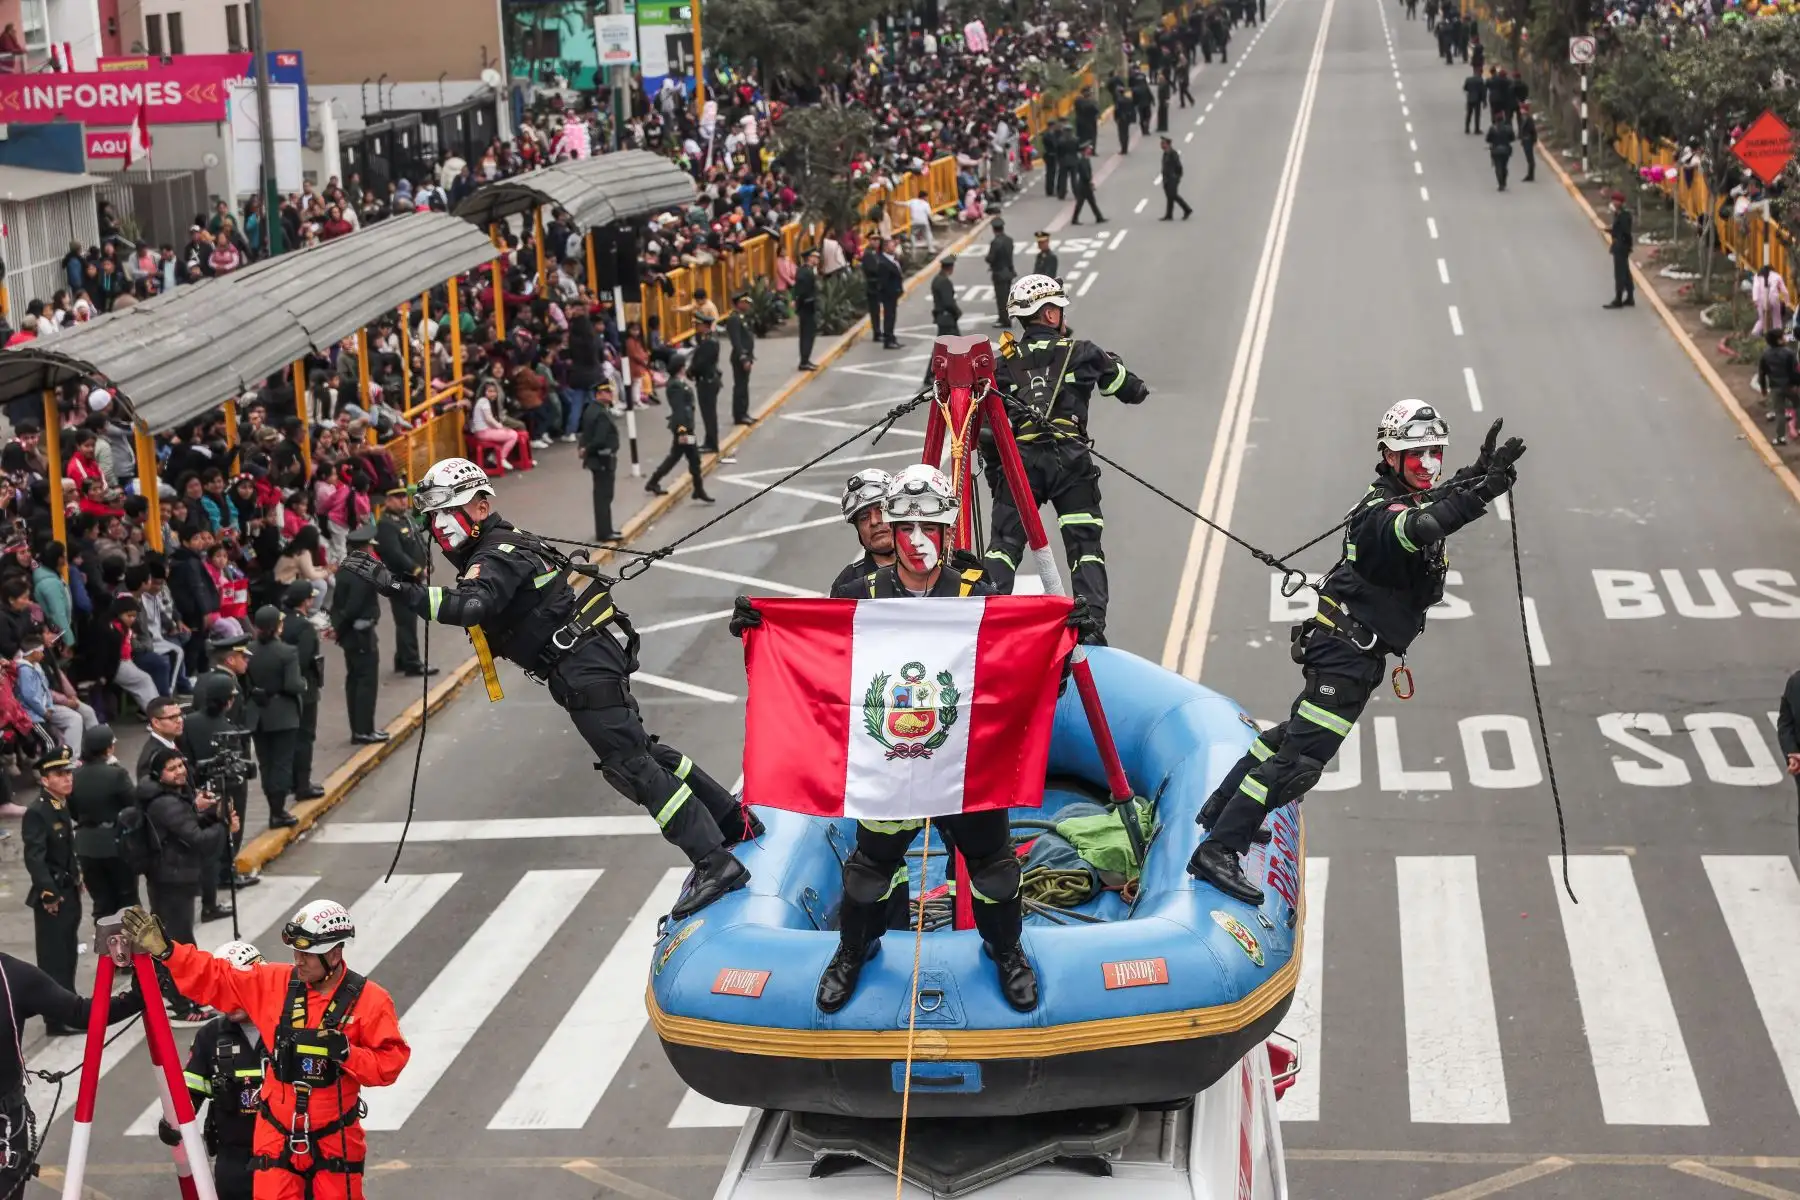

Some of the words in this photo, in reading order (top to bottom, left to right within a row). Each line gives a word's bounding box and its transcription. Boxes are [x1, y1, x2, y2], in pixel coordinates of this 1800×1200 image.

[23, 81, 182, 109] INFORMES
[91, 139, 128, 154] AQU
[1269, 569, 1474, 622] BS
[1592, 568, 1800, 619] BUS
[1597, 711, 1783, 788] SO
[720, 969, 760, 994] HYSIDE
[1113, 960, 1159, 986] HYSIDE
